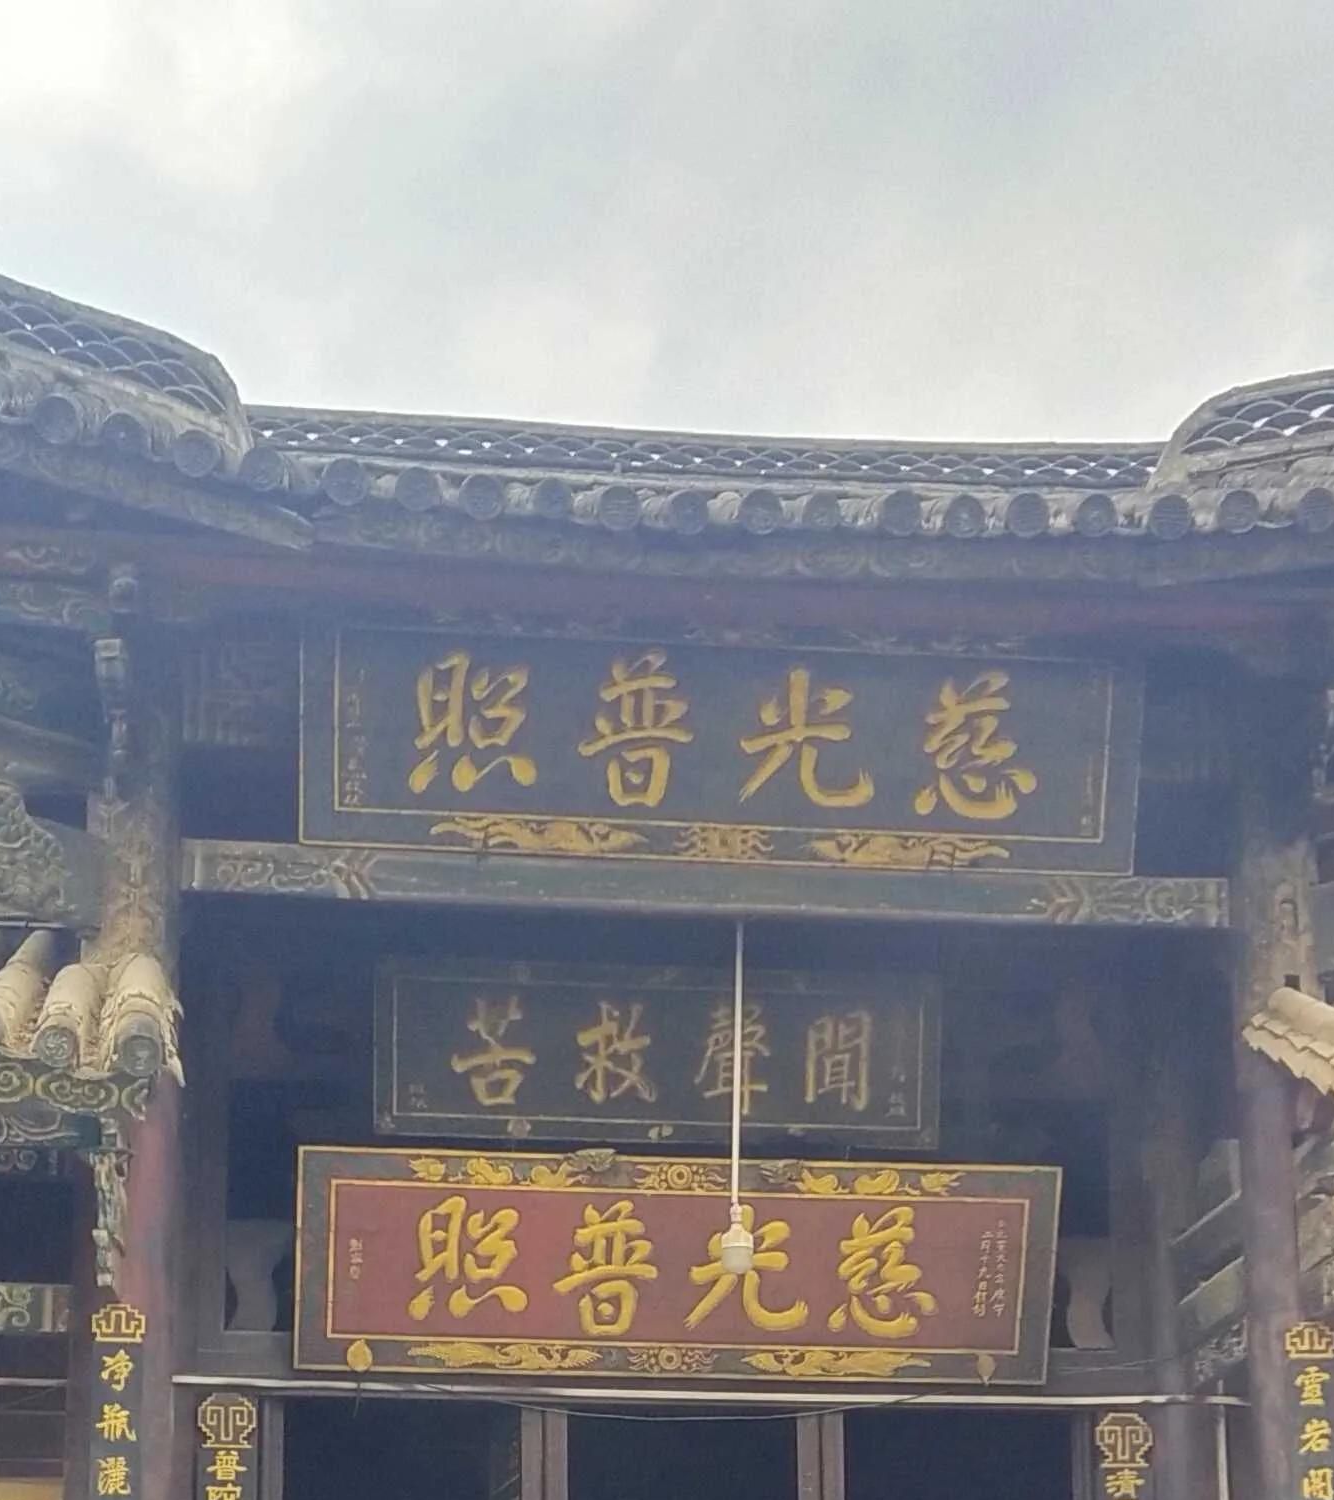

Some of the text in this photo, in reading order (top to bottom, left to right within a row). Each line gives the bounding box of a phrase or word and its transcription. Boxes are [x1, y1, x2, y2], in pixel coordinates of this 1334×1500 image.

[408, 650, 1037, 818] 慈光普照
[451, 998, 872, 1115] 聞聲救苦
[408, 1195, 937, 1340] 慈光普照
